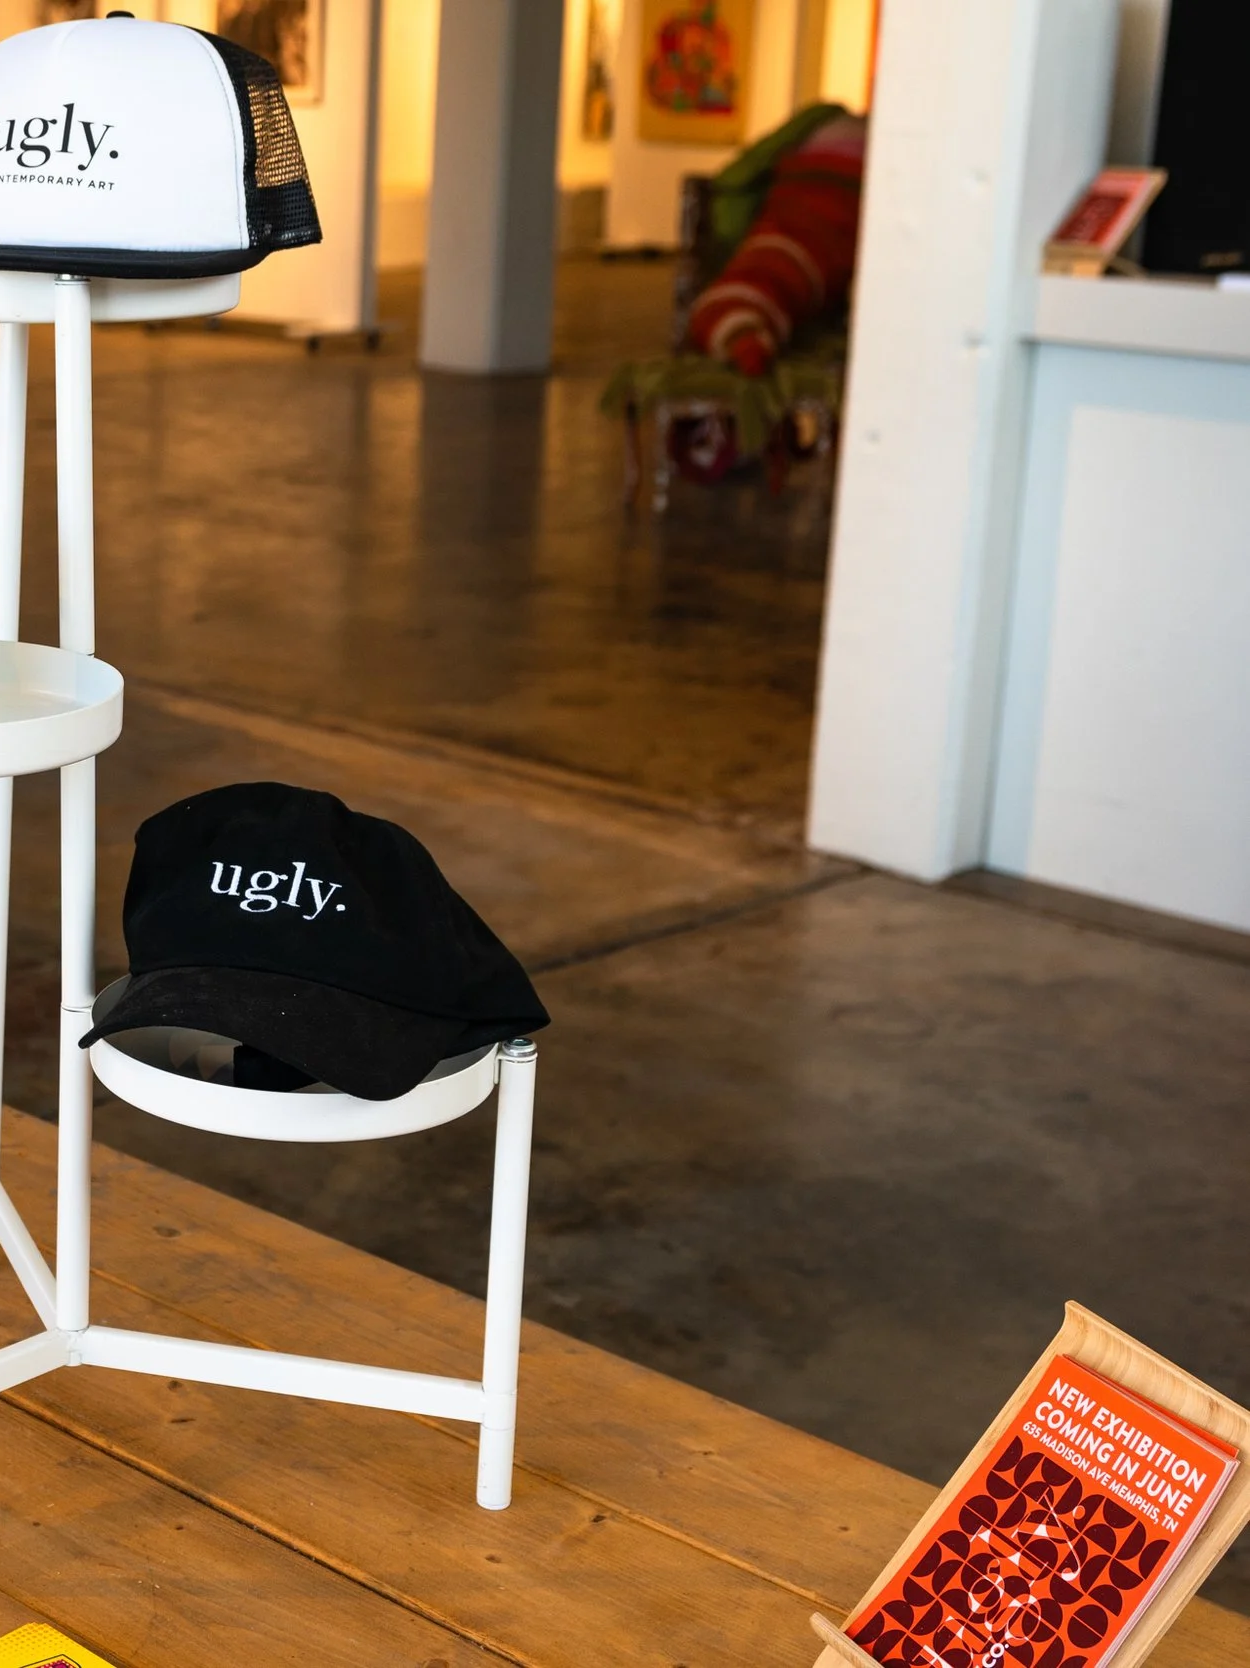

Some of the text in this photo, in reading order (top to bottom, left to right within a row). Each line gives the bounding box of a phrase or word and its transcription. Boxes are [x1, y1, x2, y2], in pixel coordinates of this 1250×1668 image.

[88, 180, 115, 191] ART
[210, 861, 346, 920] ugly.
[1022, 1421, 1179, 1533] 635 MADISON AVE MEMPHIS, TN
[1034, 1402, 1193, 1517] COMING IN JUNE
[1048, 1377, 1207, 1493] NEW EXHIBITION
